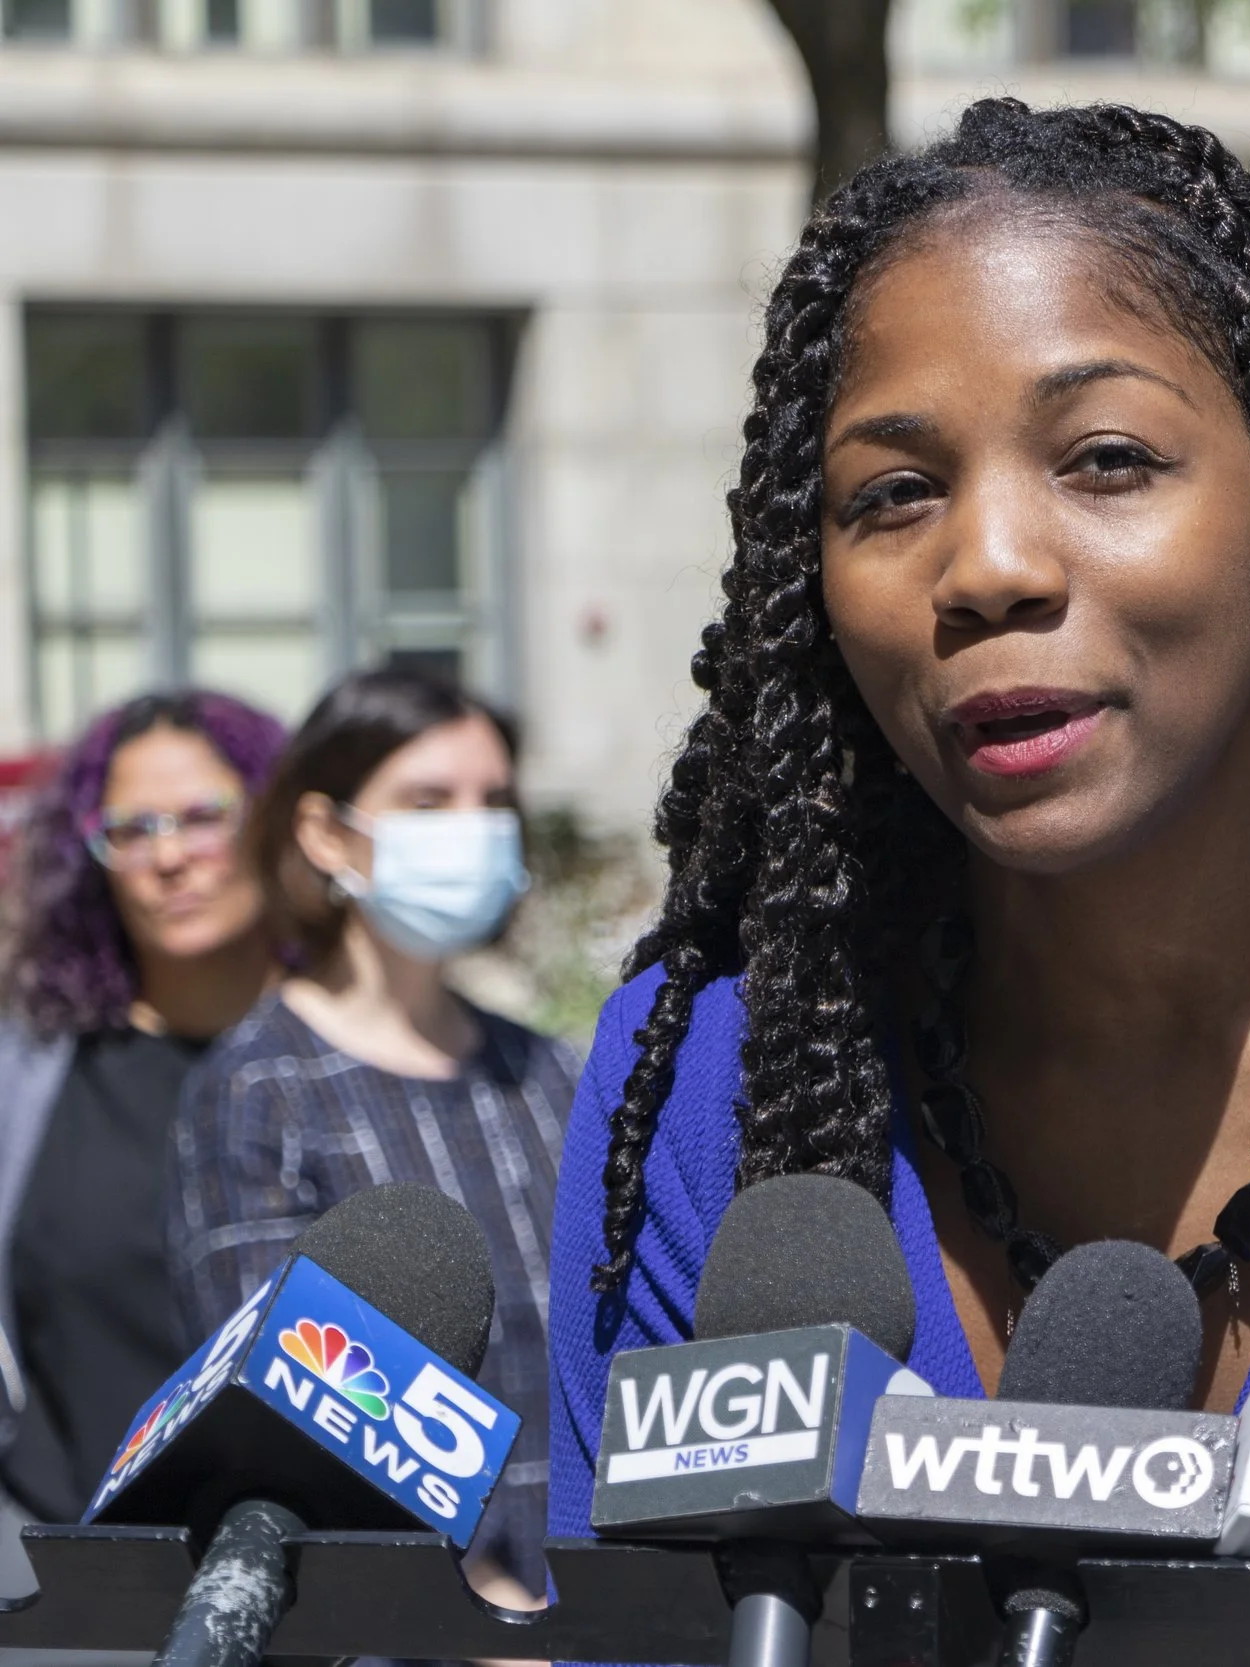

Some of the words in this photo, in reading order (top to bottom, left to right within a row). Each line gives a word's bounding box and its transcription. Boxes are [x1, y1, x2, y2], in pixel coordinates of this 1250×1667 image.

[264, 1357, 461, 1519] NEWS
[393, 1362, 498, 1479] 5
[619, 1352, 829, 1450] WGN
[673, 1443, 749, 1471] NEWS
[884, 1425, 1133, 1501] wttw
